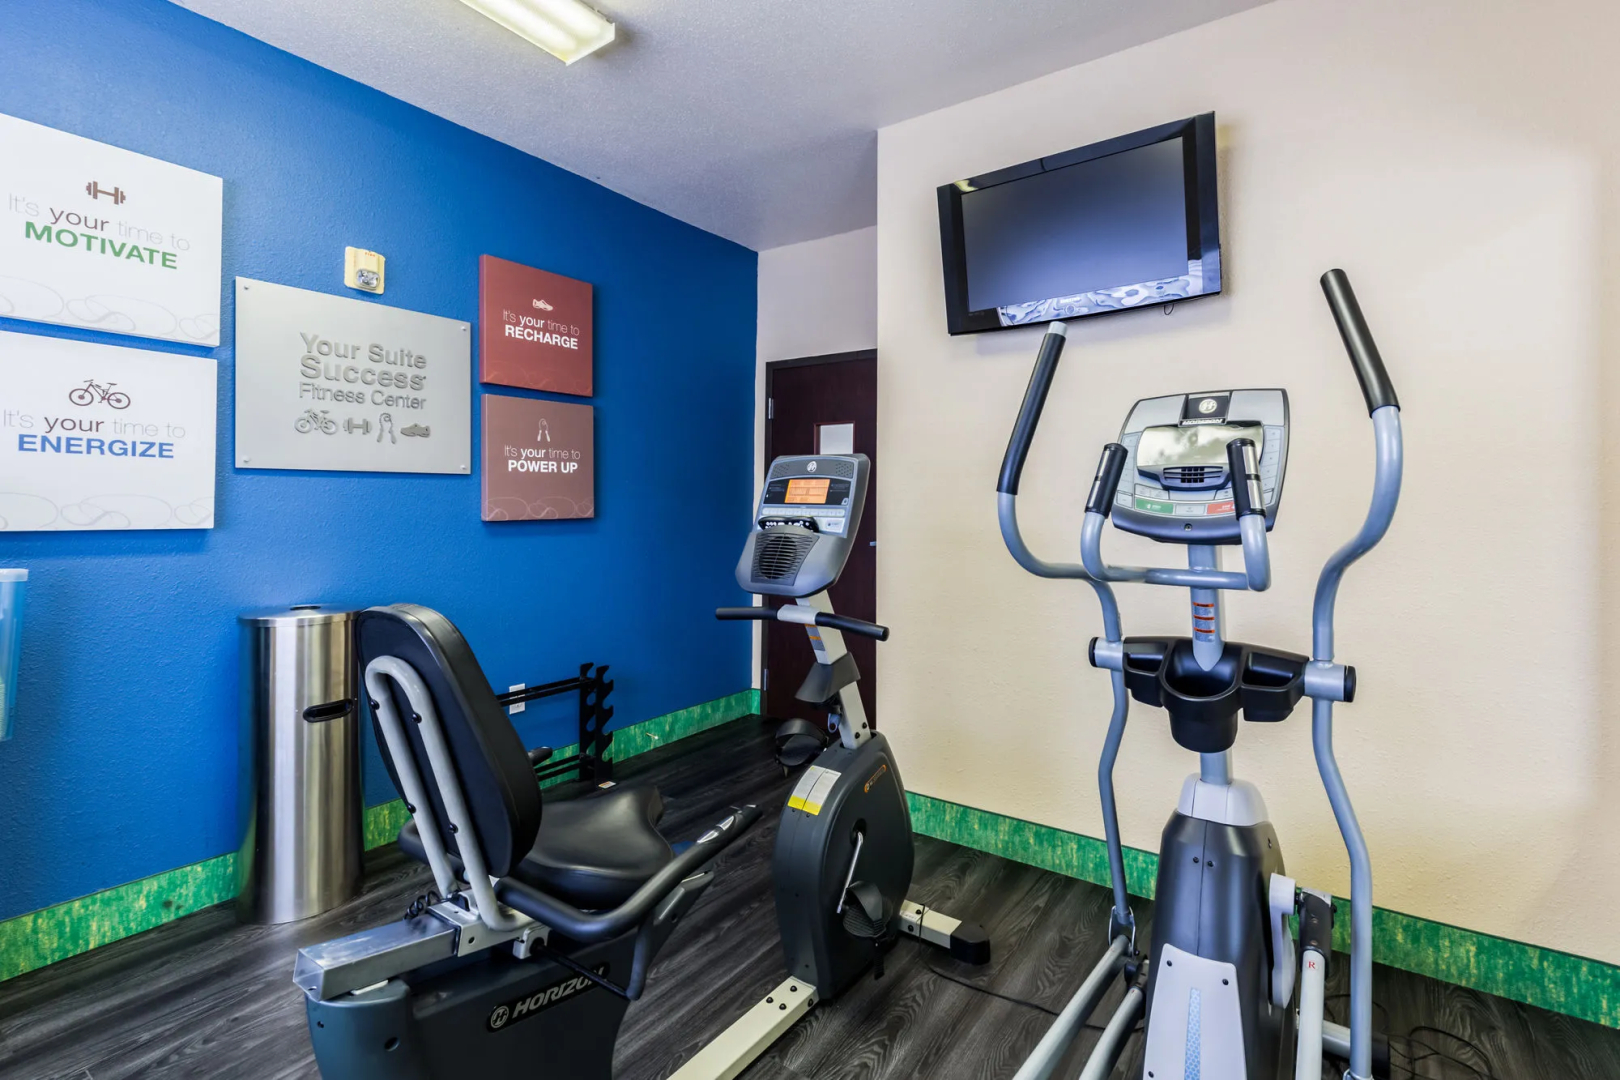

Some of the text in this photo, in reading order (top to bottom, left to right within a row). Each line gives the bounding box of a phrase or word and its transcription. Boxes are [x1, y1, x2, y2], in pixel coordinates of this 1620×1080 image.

[9, 193, 191, 252] It's your time to
[25, 221, 178, 270] MOTIVATE
[503, 309, 580, 336] It's your time to
[300, 332, 427, 369] Your Suite
[505, 324, 578, 350] RECHARGE
[299, 381, 427, 410] Fitness Center
[3, 409, 186, 439] It's your time to
[18, 433, 174, 459] ENERGIZE
[504, 445, 581, 460] It's your time to
[508, 460, 578, 473] POWER UP
[1308, 960, 1316, 970] R
